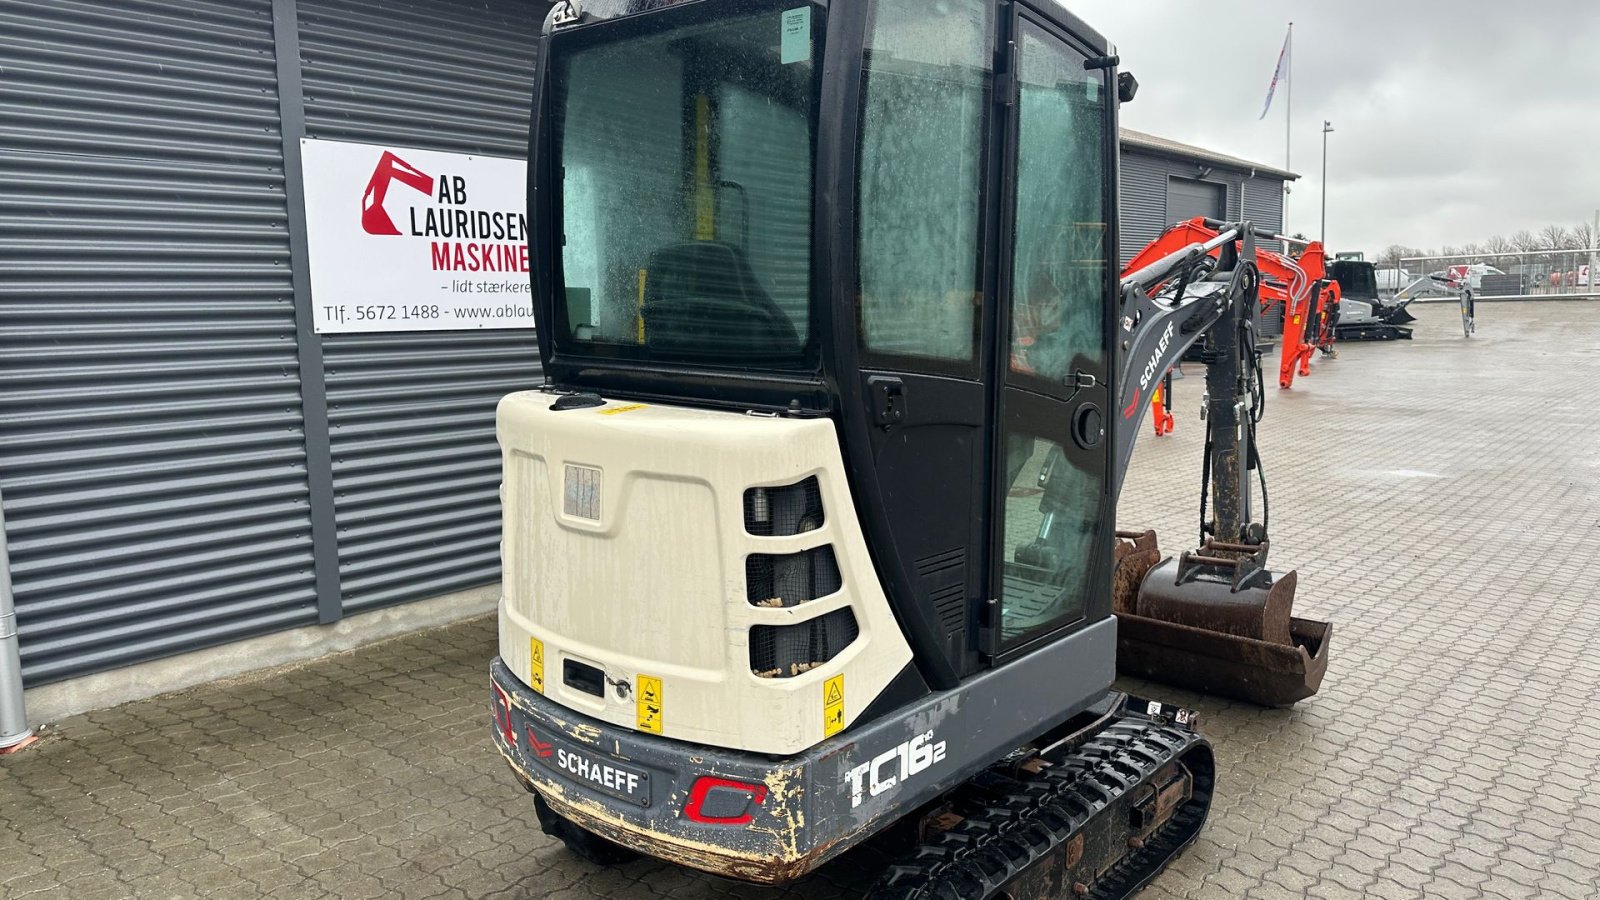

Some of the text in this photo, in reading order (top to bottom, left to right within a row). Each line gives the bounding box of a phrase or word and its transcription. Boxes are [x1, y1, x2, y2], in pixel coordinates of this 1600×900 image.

[438, 175, 467, 205] AB
[409, 206, 527, 241] LAURIDSEN
[431, 241, 530, 273] MASKINE
[452, 279, 473, 293] lidt
[476, 280, 531, 294] stærkere
[323, 305, 351, 324] Tlf.
[356, 305, 397, 321] 5672
[402, 304, 440, 320] 1488
[1140, 320, 1174, 391] SCHAEFF
[557, 748, 639, 794] SCHAEFF
